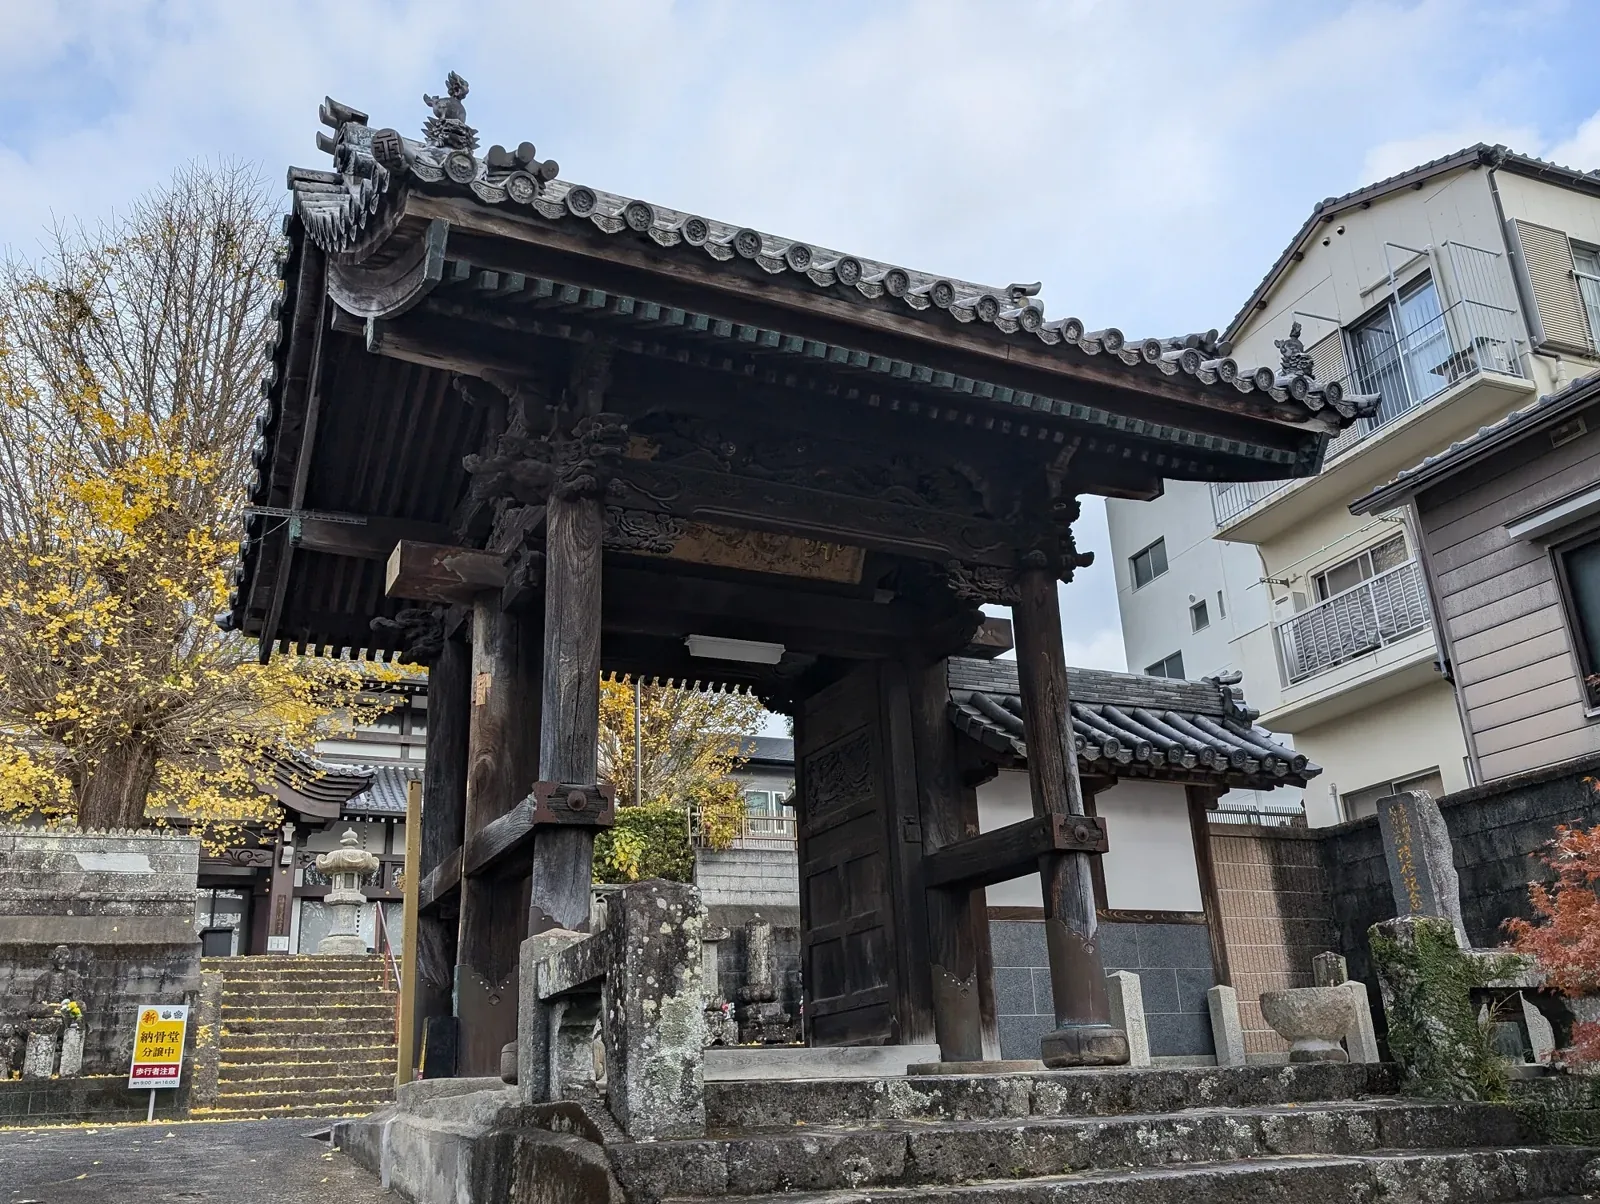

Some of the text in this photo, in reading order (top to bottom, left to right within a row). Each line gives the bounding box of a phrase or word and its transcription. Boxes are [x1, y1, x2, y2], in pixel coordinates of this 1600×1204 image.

[142, 1011, 156, 1024] 新
[140, 1031, 180, 1043] 納骨堂
[142, 1046, 175, 1057] 分譲中
[136, 1067, 176, 1075] 歩行者注意
